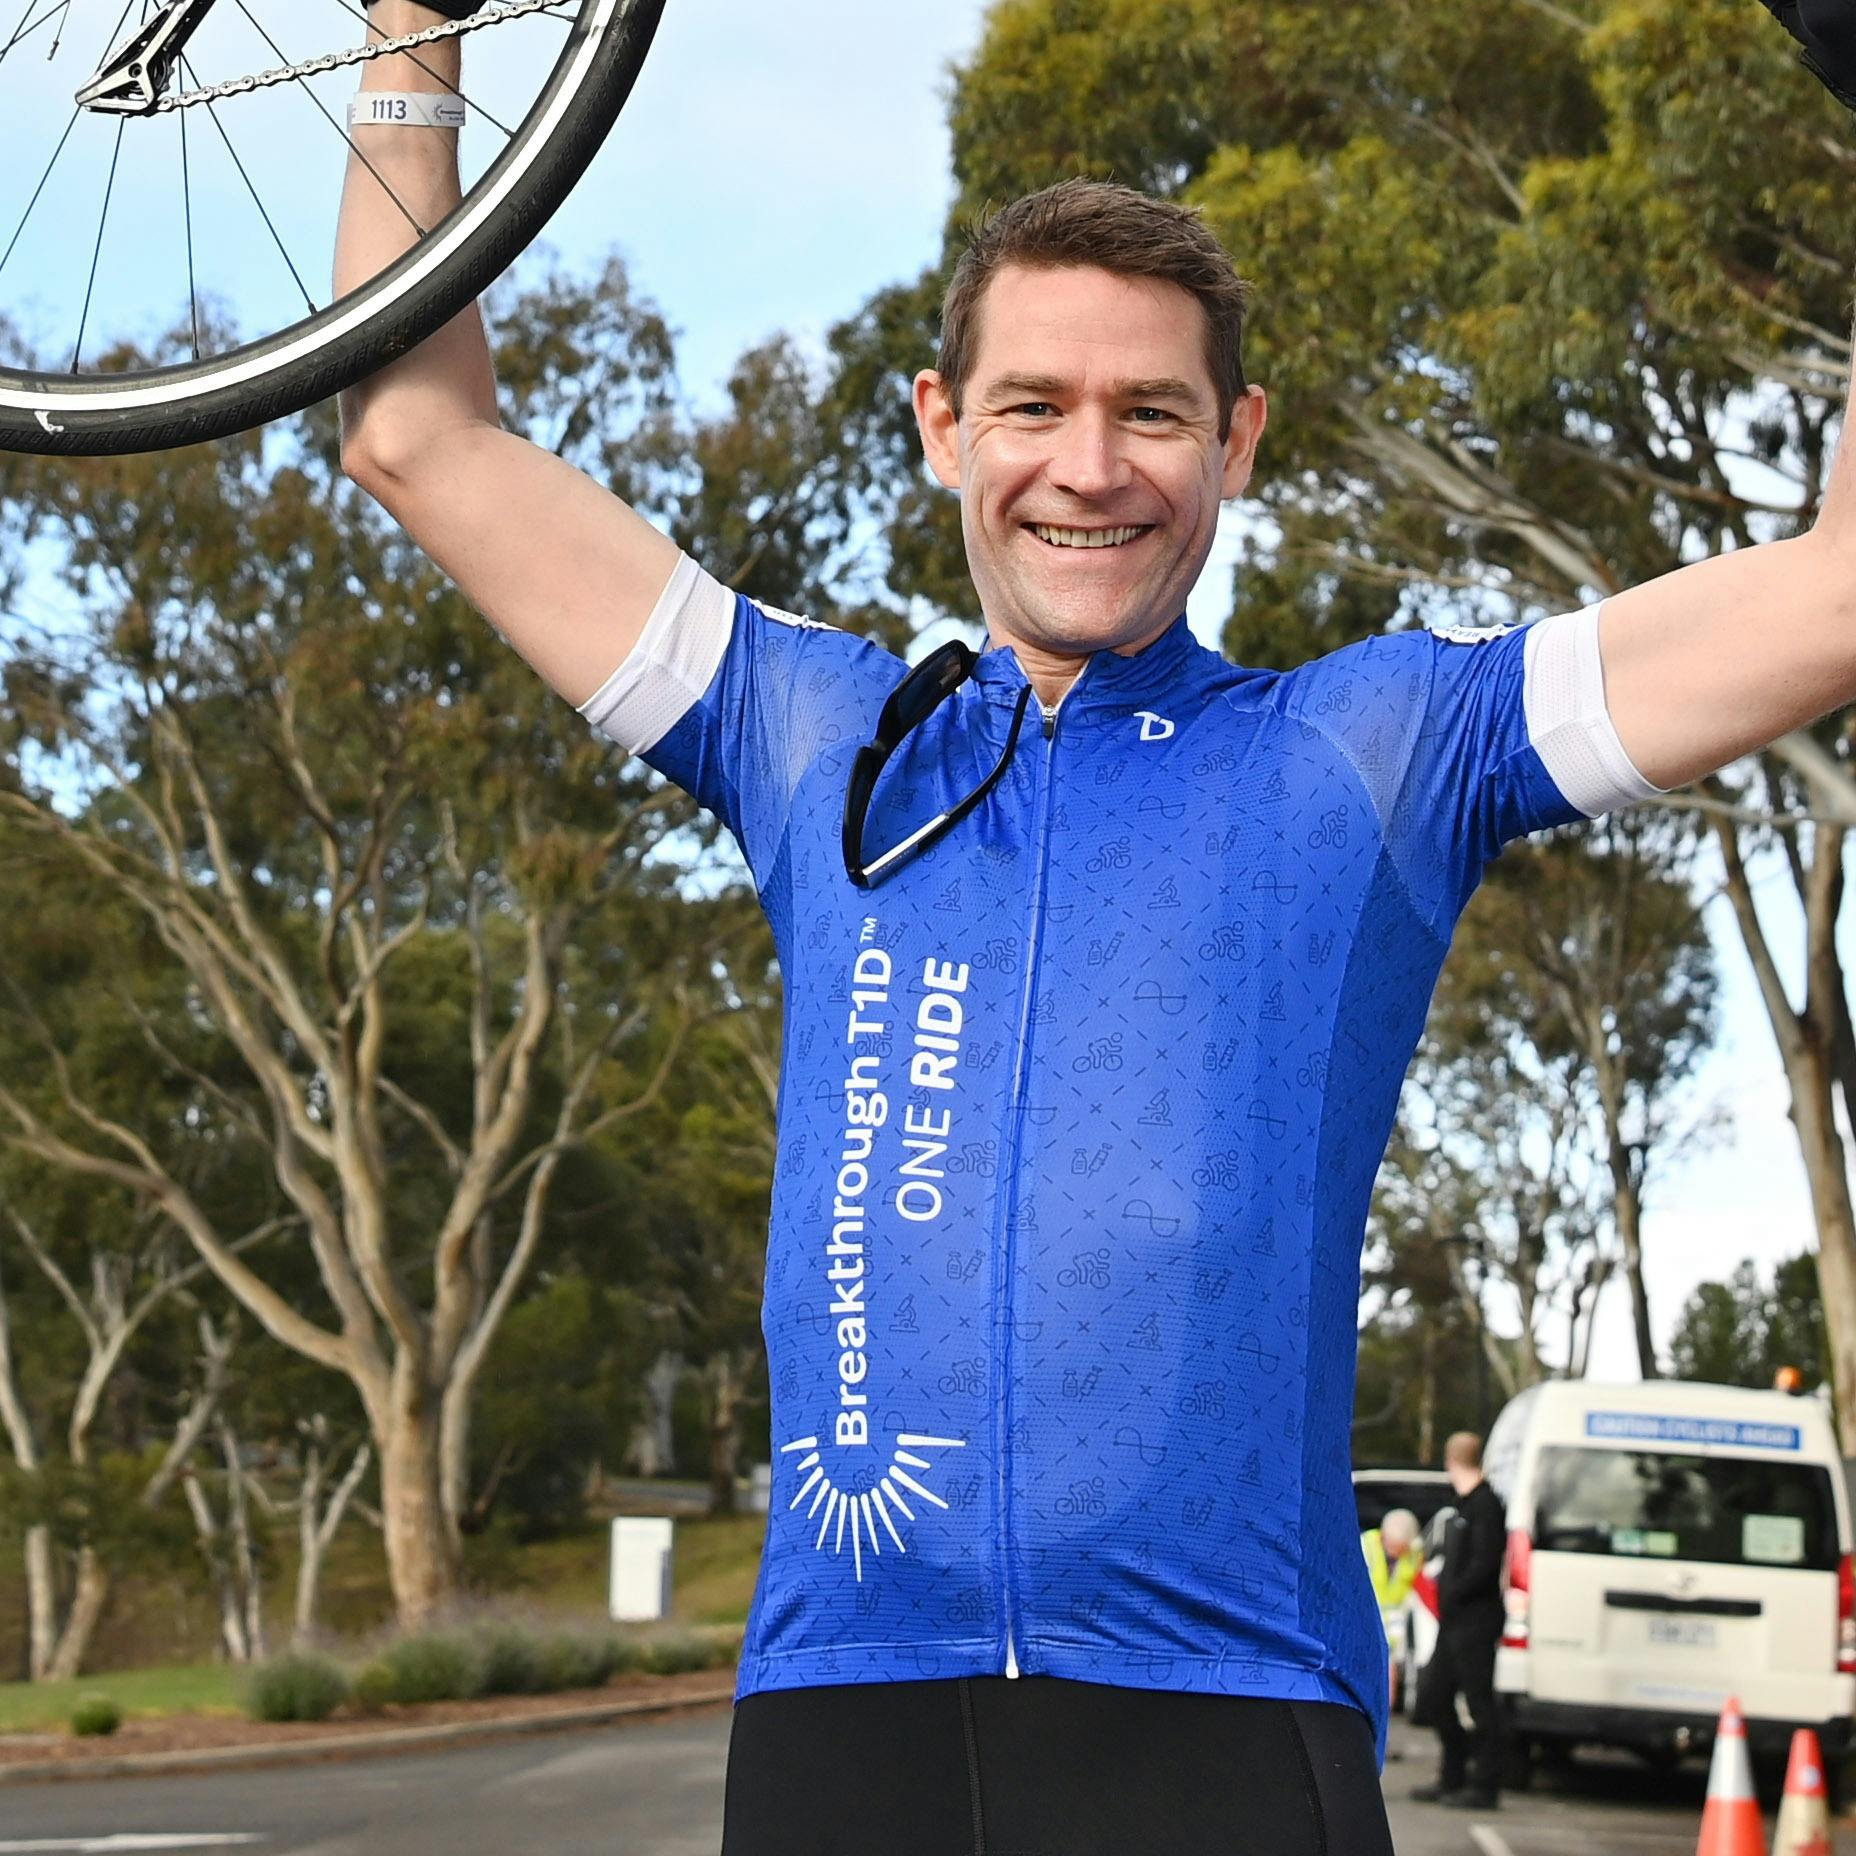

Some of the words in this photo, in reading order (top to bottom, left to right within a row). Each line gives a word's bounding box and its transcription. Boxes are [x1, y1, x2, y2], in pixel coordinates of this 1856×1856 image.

[372, 99, 407, 120] 1113
[910, 956, 970, 1090] RIDE
[895, 1103, 951, 1222] ONE
[826, 1055, 888, 1446] Breakthrough
